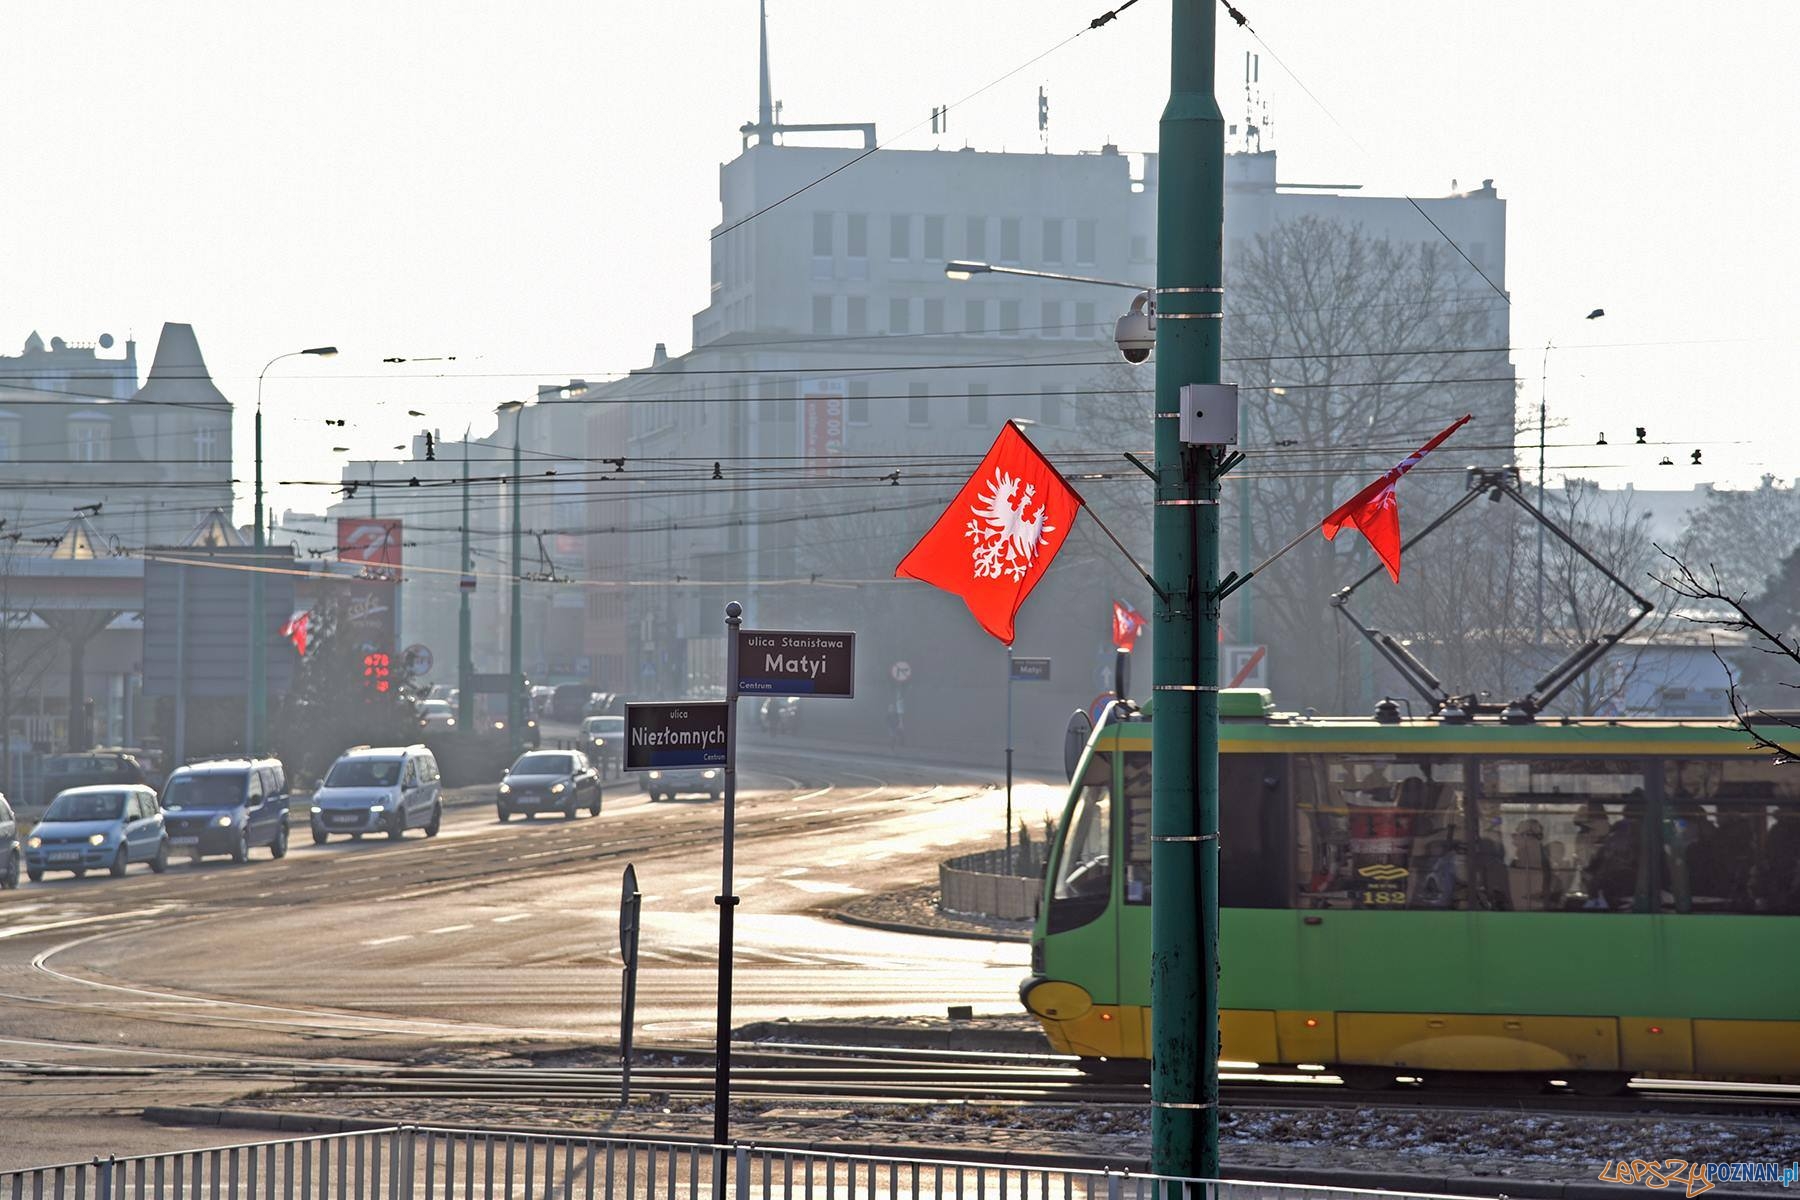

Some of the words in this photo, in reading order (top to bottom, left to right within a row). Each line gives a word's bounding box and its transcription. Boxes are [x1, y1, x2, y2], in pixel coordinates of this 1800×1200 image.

[748, 636, 775, 647] ulica
[781, 637, 844, 648] Stanisława
[765, 653, 827, 679] Matyi
[1020, 665, 1042, 675] Matyi
[739, 681, 772, 689] Centrum
[670, 708, 688, 719] ulica
[632, 724, 725, 750] Niezłomnych
[703, 753, 725, 761] Centrum
[1363, 891, 1406, 904] 182
